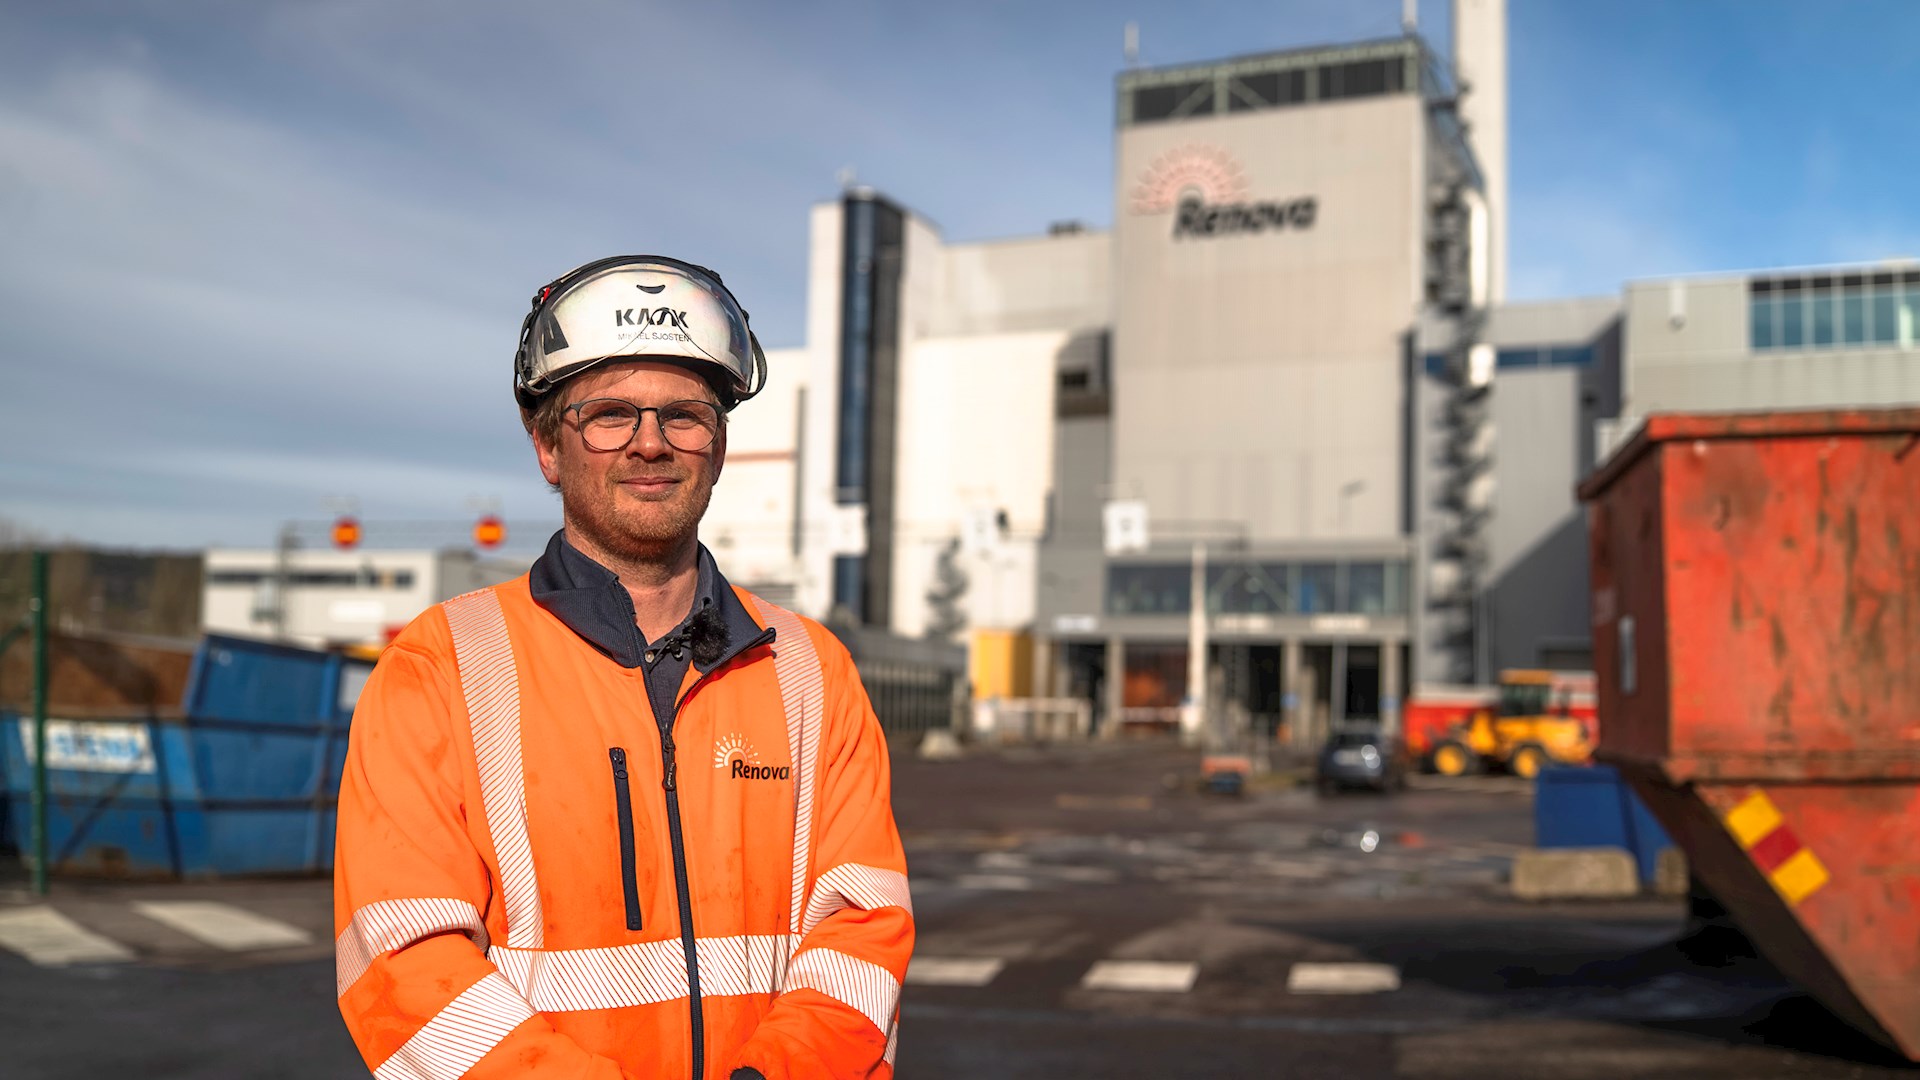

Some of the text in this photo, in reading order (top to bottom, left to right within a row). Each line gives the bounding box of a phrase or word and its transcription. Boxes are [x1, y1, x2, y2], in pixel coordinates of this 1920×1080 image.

[1173, 194, 1318, 242] Renova
[615, 308, 689, 328] KASK
[732, 759, 790, 780] Renova
